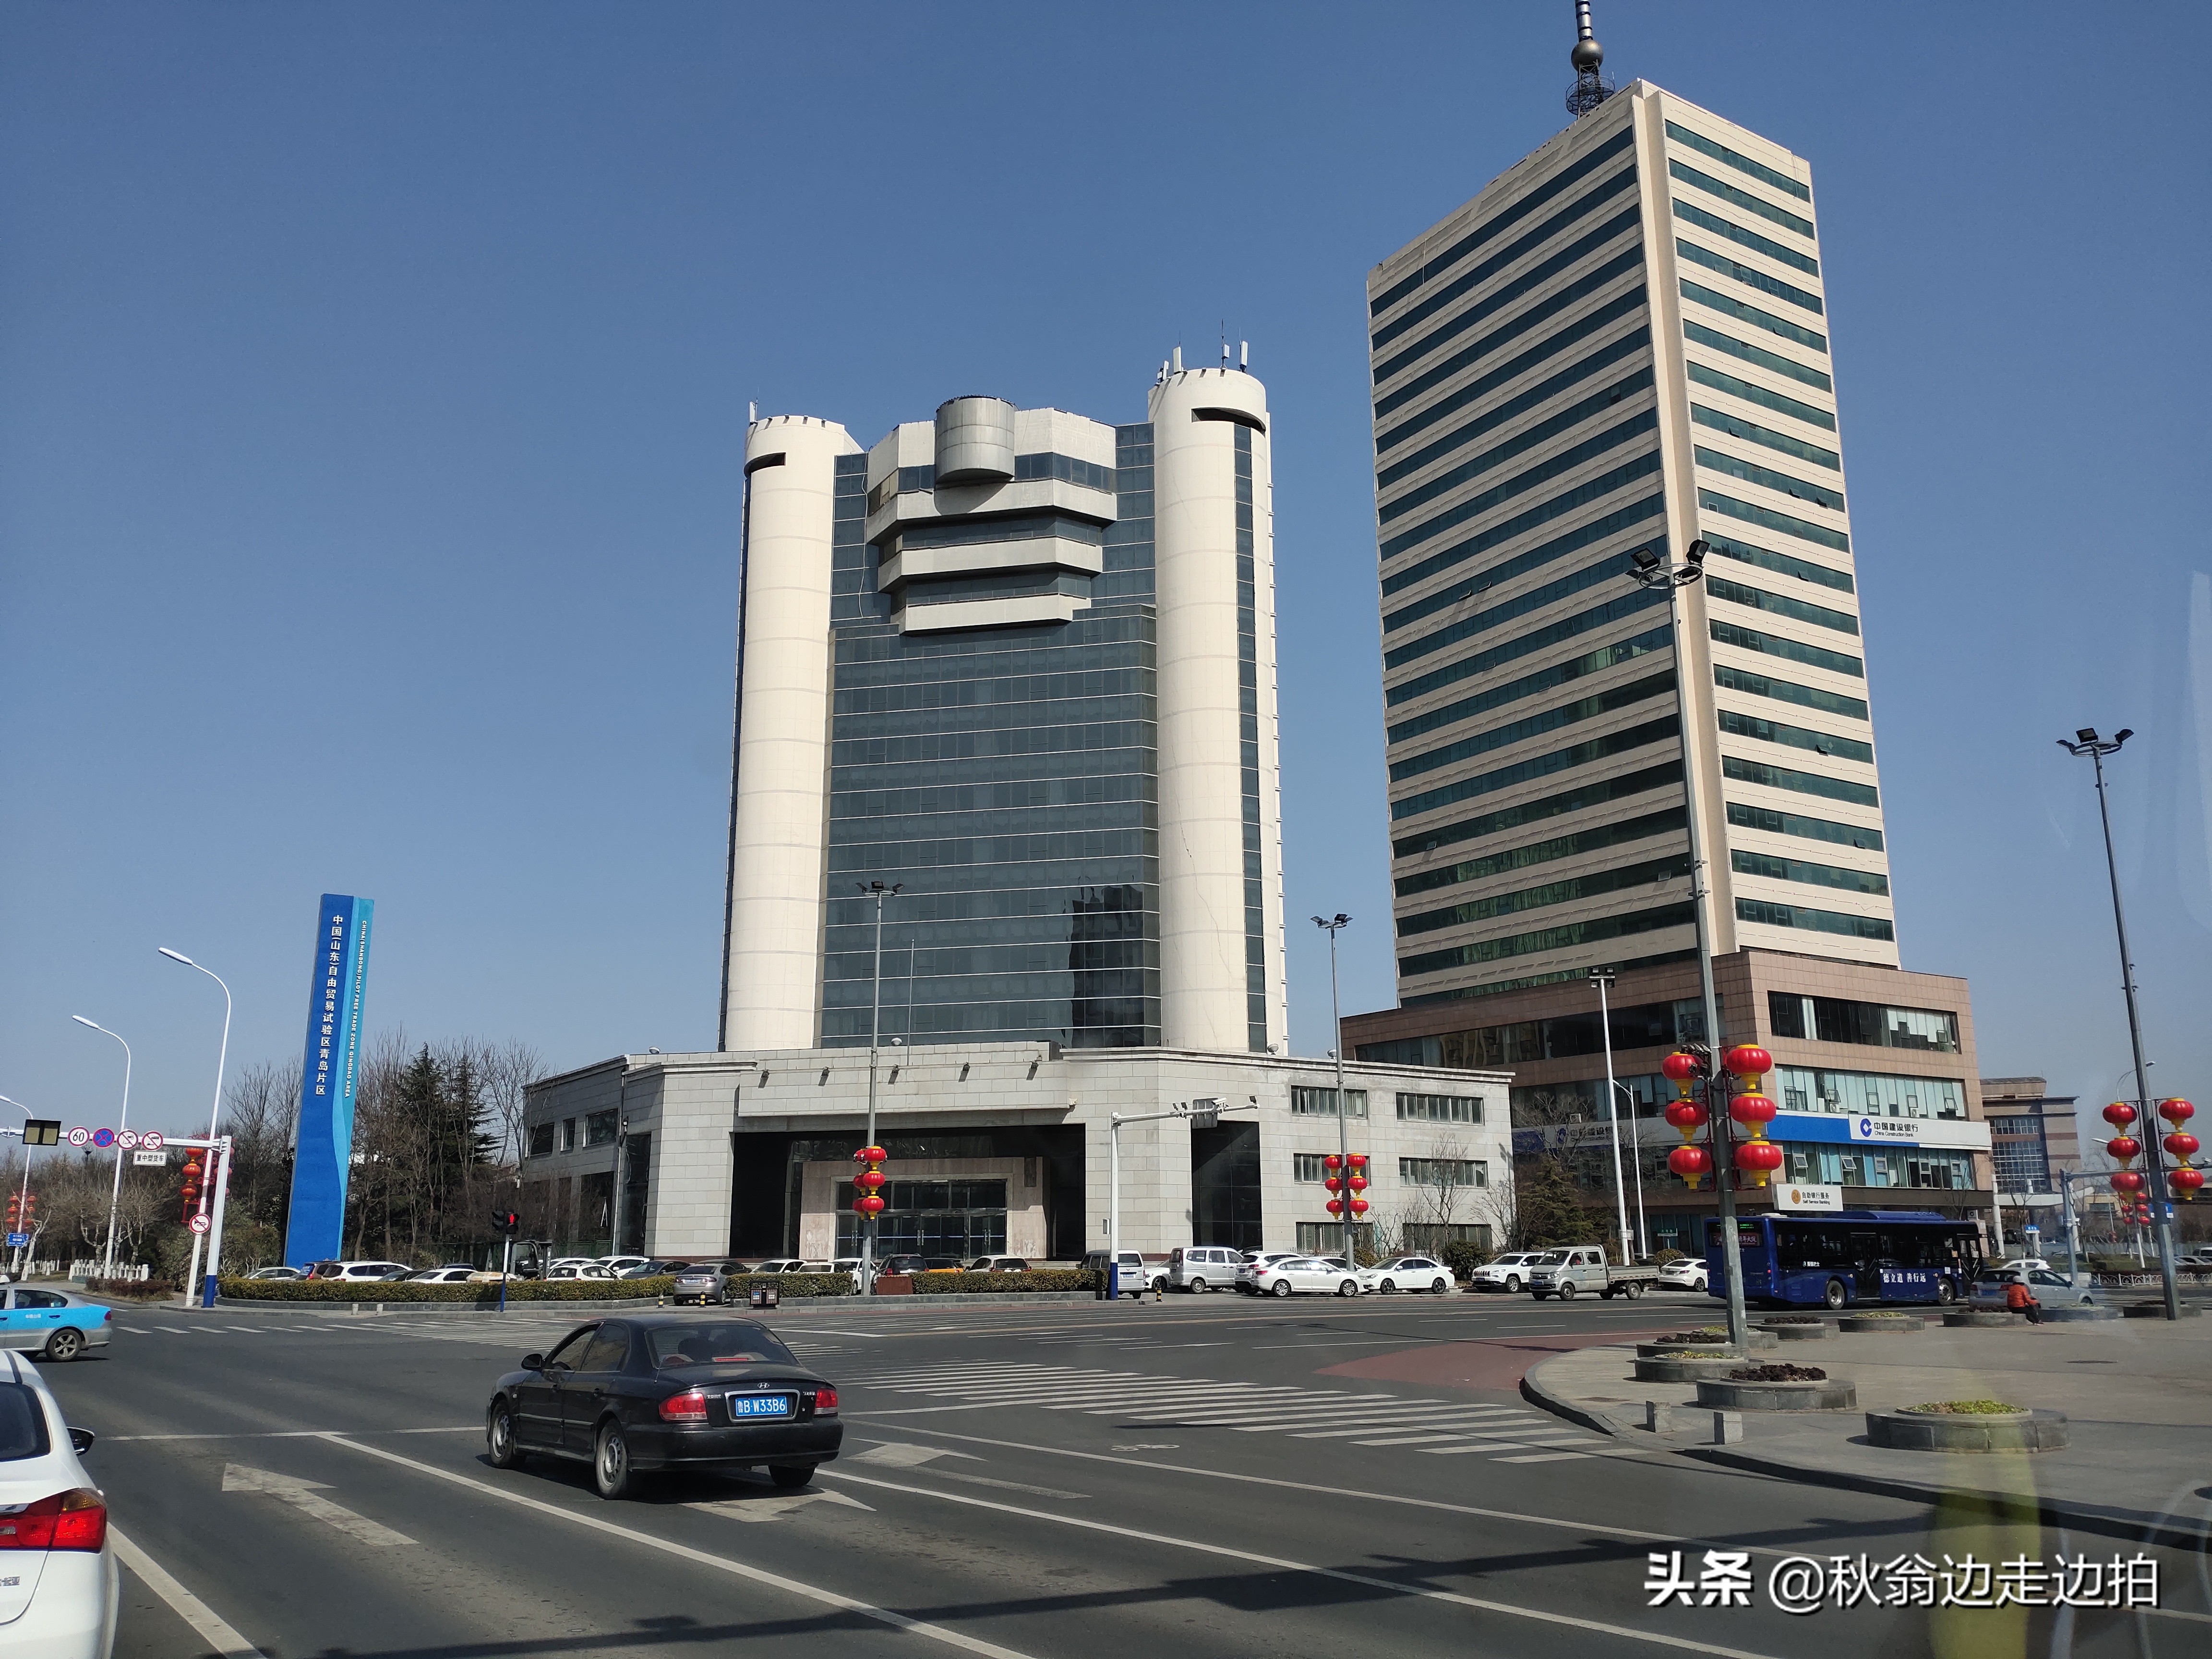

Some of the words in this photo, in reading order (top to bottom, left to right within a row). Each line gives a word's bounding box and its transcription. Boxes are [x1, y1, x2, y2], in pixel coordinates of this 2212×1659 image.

[315, 914, 343, 1095] 中国（山东）自由贸易试验区青岛片区
[1874, 1122, 1918, 1132] 中国建设银行
[72, 1131, 84, 1142] 60
[136, 1154, 164, 1162] 重中型货车
